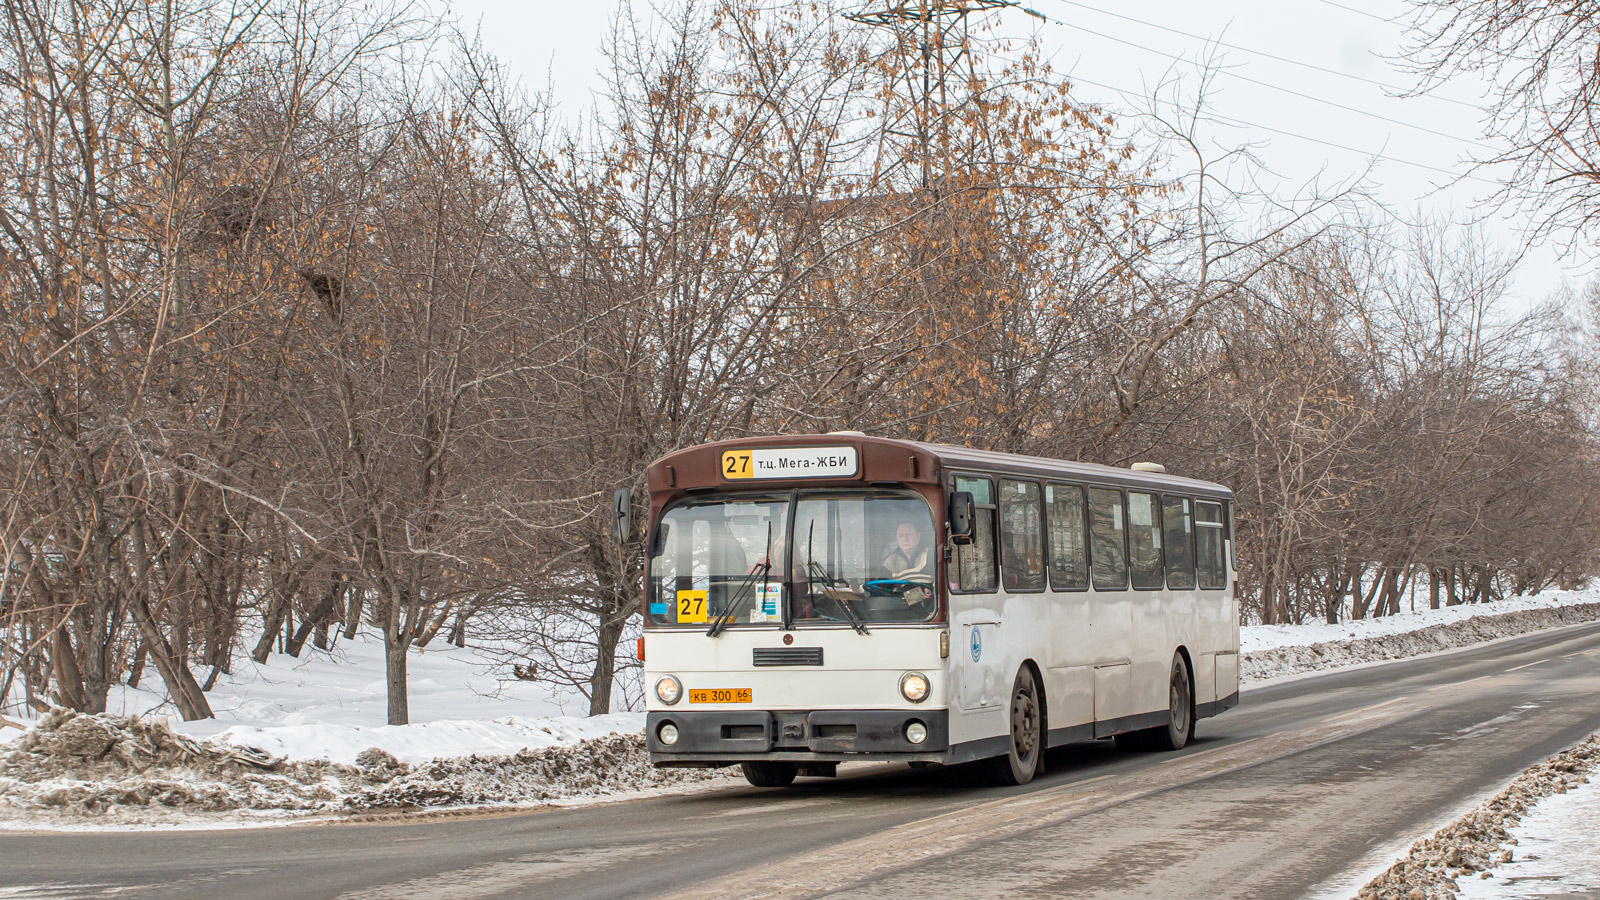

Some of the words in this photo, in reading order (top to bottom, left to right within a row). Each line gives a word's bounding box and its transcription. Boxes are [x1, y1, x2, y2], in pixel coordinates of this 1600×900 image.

[726, 456, 750, 473] 27
[680, 598, 704, 616] 27
[711, 690, 732, 702] 300
[737, 689, 748, 698] 66
